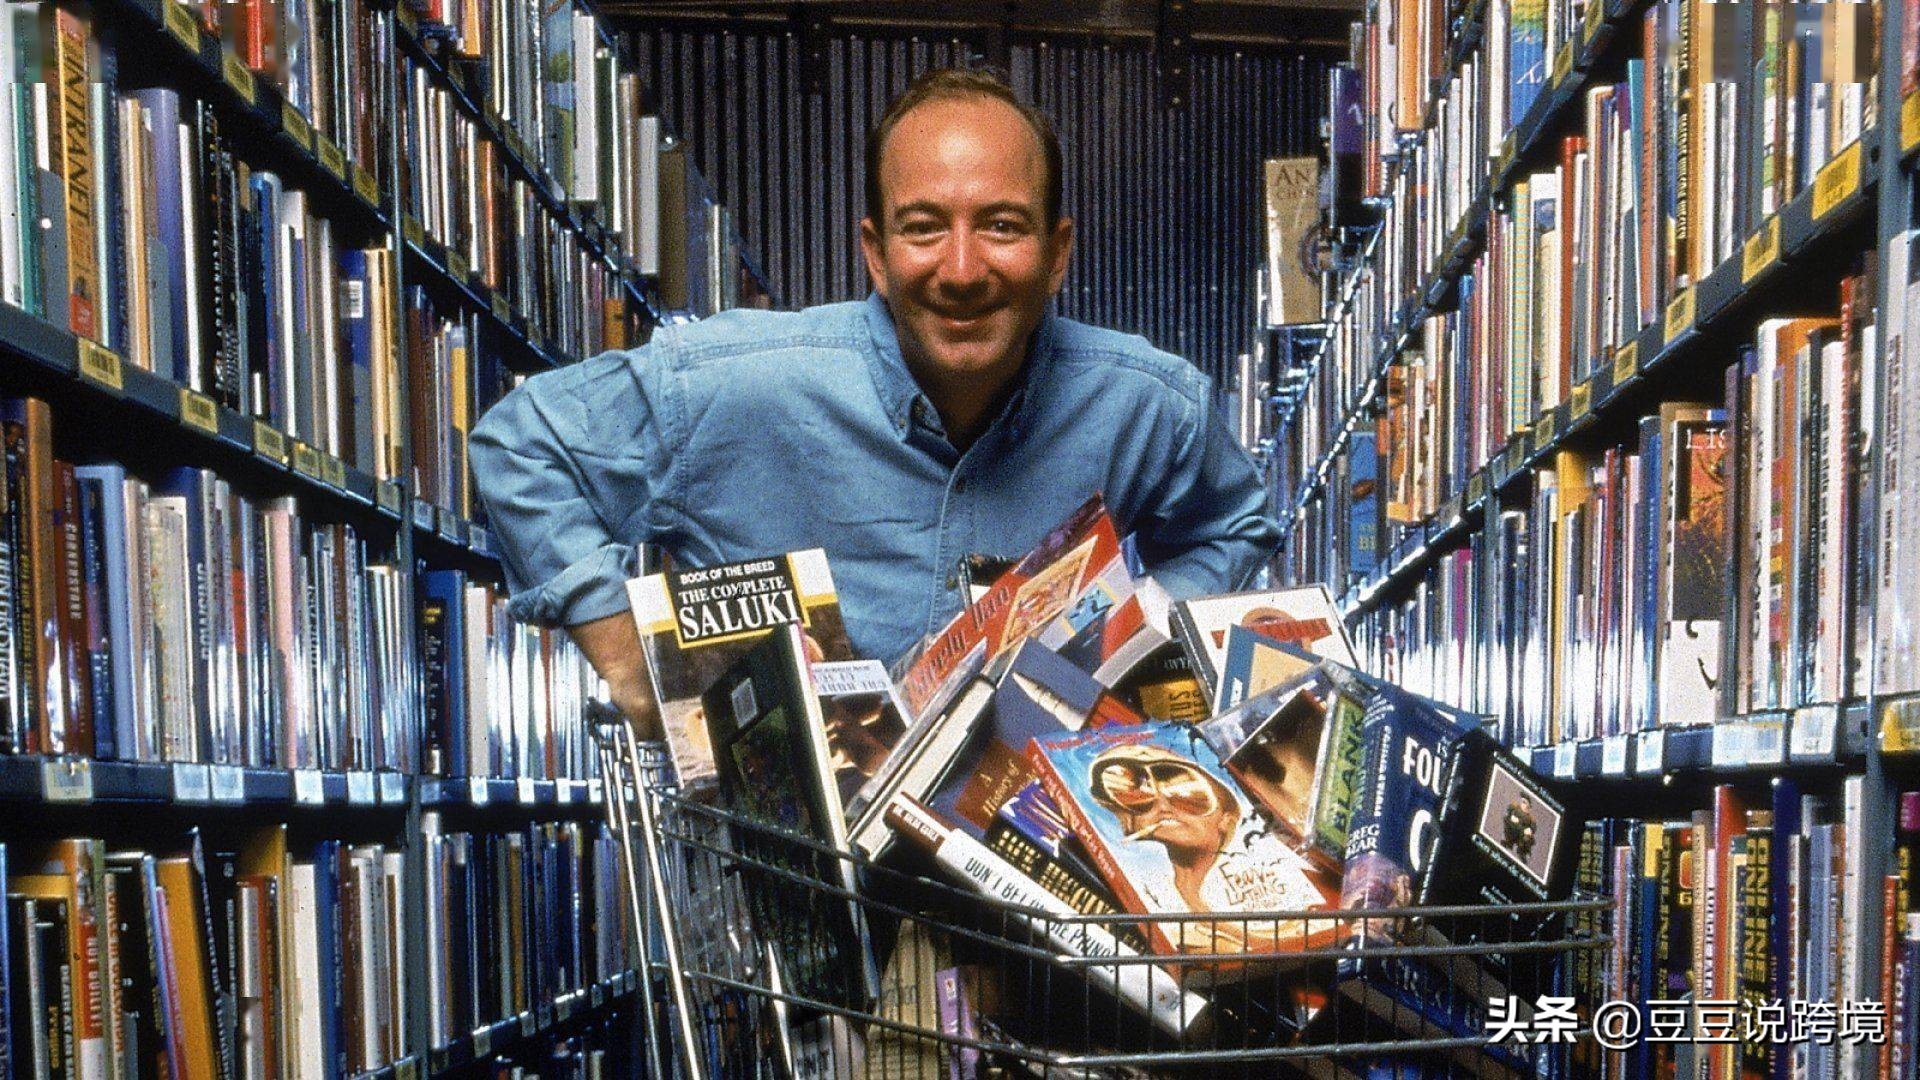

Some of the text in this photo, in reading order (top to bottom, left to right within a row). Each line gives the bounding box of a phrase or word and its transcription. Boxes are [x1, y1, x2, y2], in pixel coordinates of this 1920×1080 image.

[63, 50, 91, 225] INTRANET
[65, 522, 82, 620] CORNERSTONE
[678, 575, 787, 606] THE COMPLETE
[680, 560, 775, 586] BOOK OF THE BREED
[678, 588, 800, 641] SALUKI
